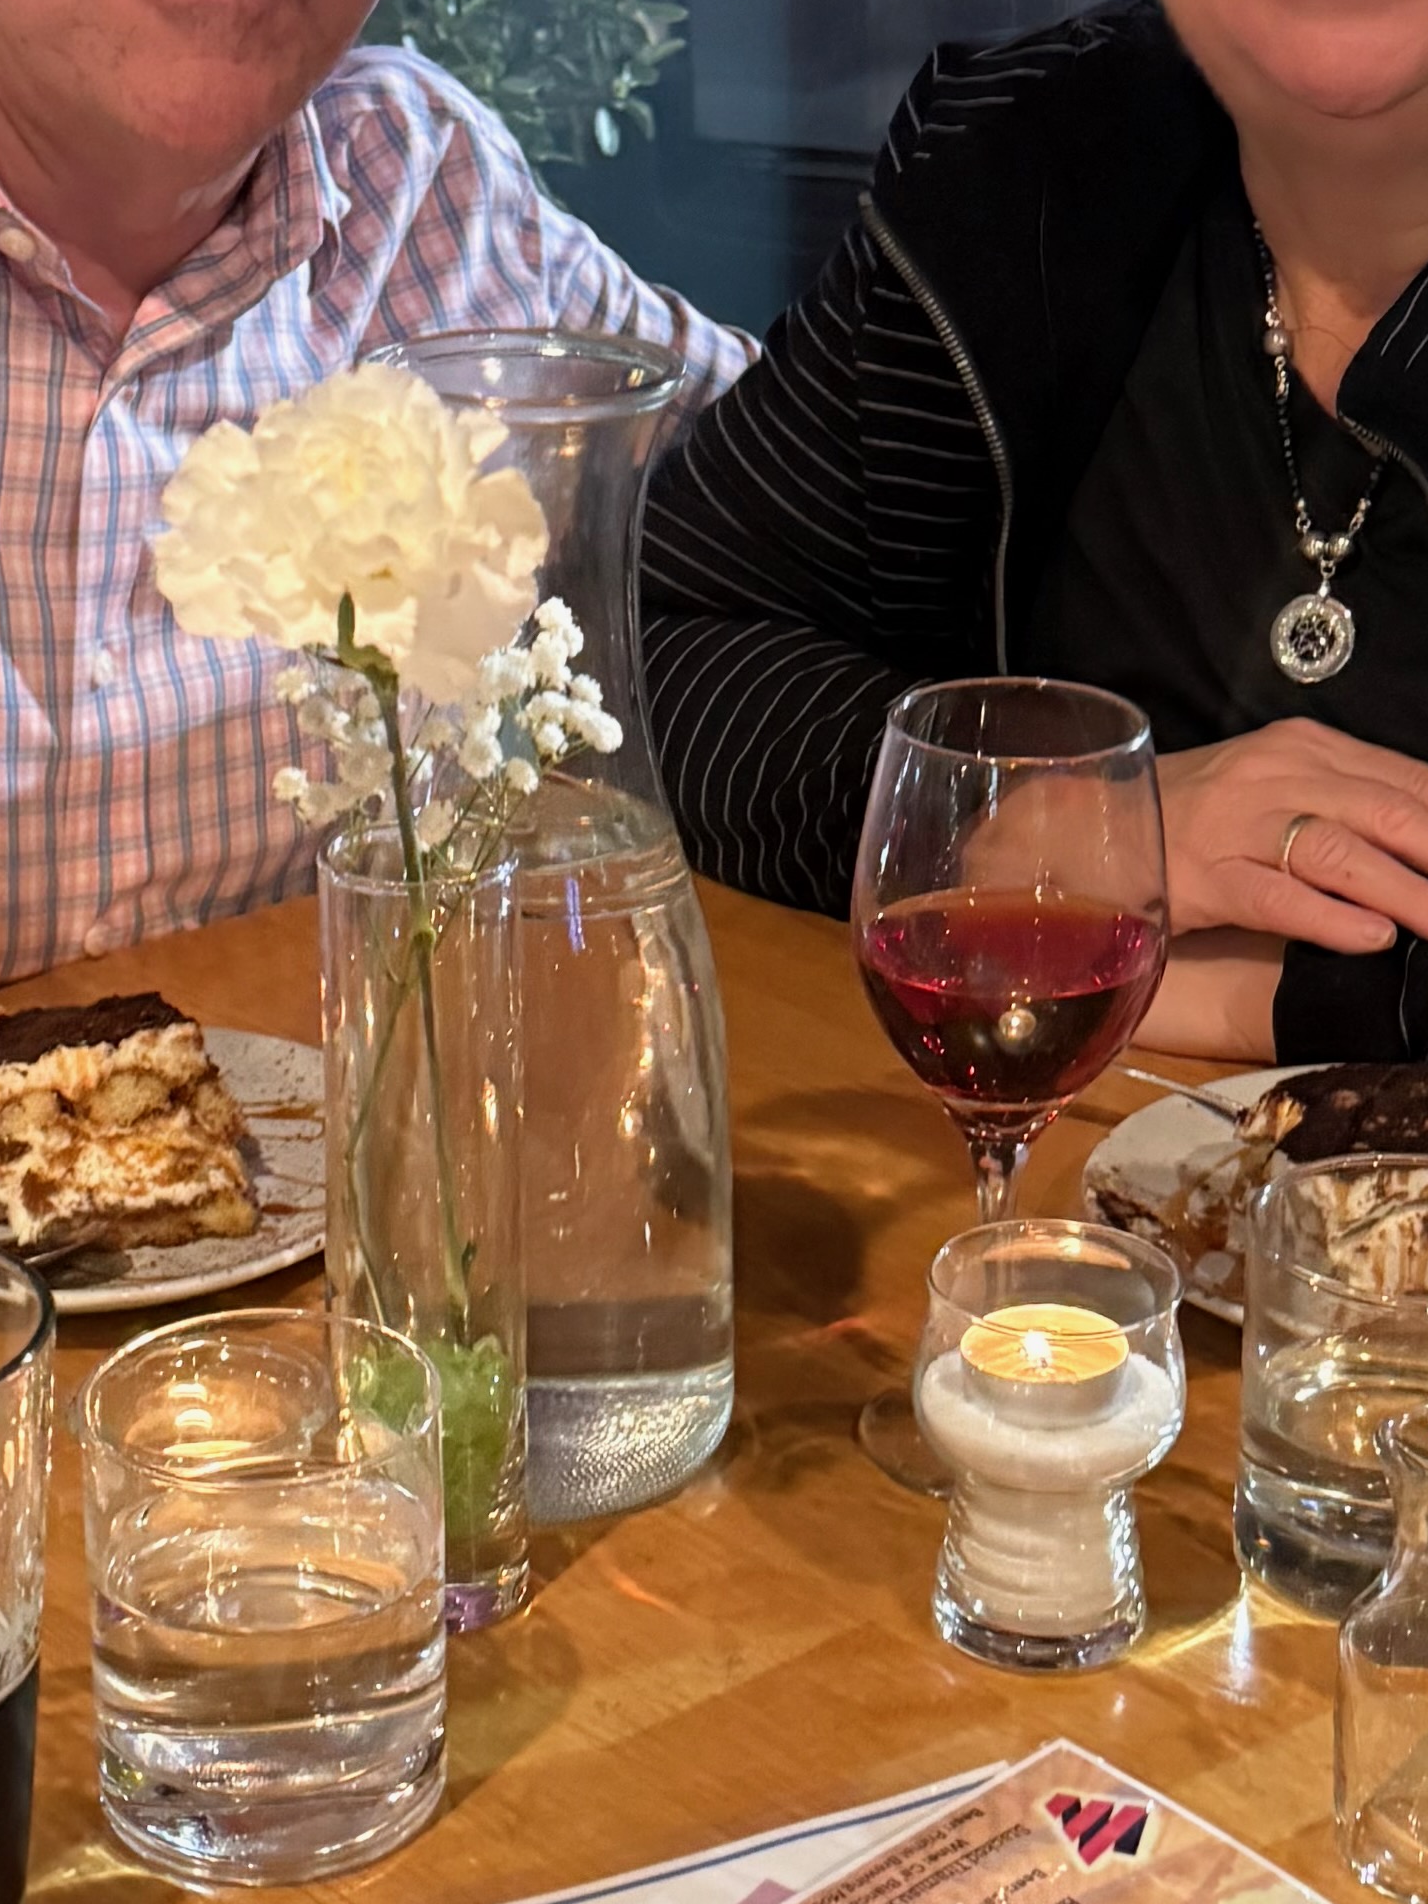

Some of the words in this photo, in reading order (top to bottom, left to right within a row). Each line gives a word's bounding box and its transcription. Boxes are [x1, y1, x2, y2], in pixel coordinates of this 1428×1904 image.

[922, 1838, 967, 1865] Wine:
[963, 1824, 1030, 1865] Stacked
[839, 1856, 903, 1891] Brewing
[897, 1861, 969, 1903] Tiramisu
